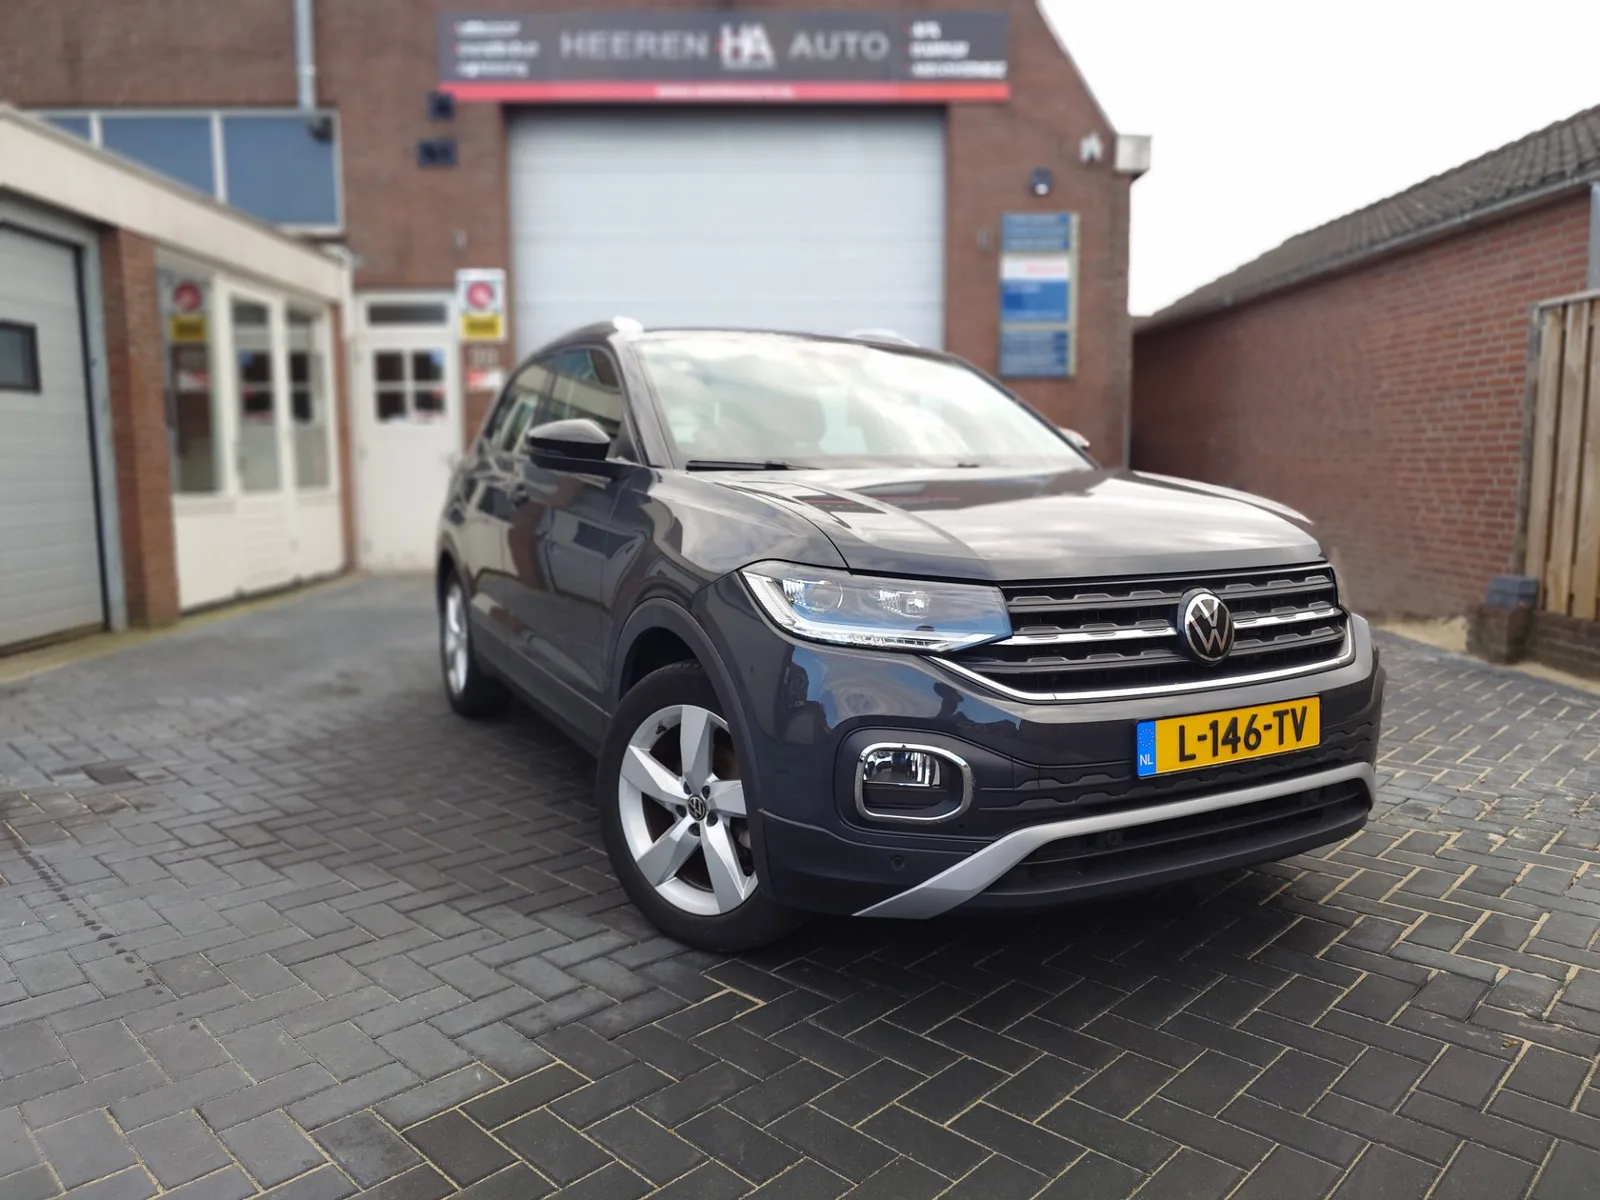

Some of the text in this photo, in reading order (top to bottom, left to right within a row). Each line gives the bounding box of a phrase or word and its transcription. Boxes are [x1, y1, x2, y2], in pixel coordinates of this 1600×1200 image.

[560, 31, 709, 59] HEEREN
[789, 31, 890, 60] AUTO
[1178, 705, 1308, 762] L-146-TV
[1139, 753, 1154, 767] NL
